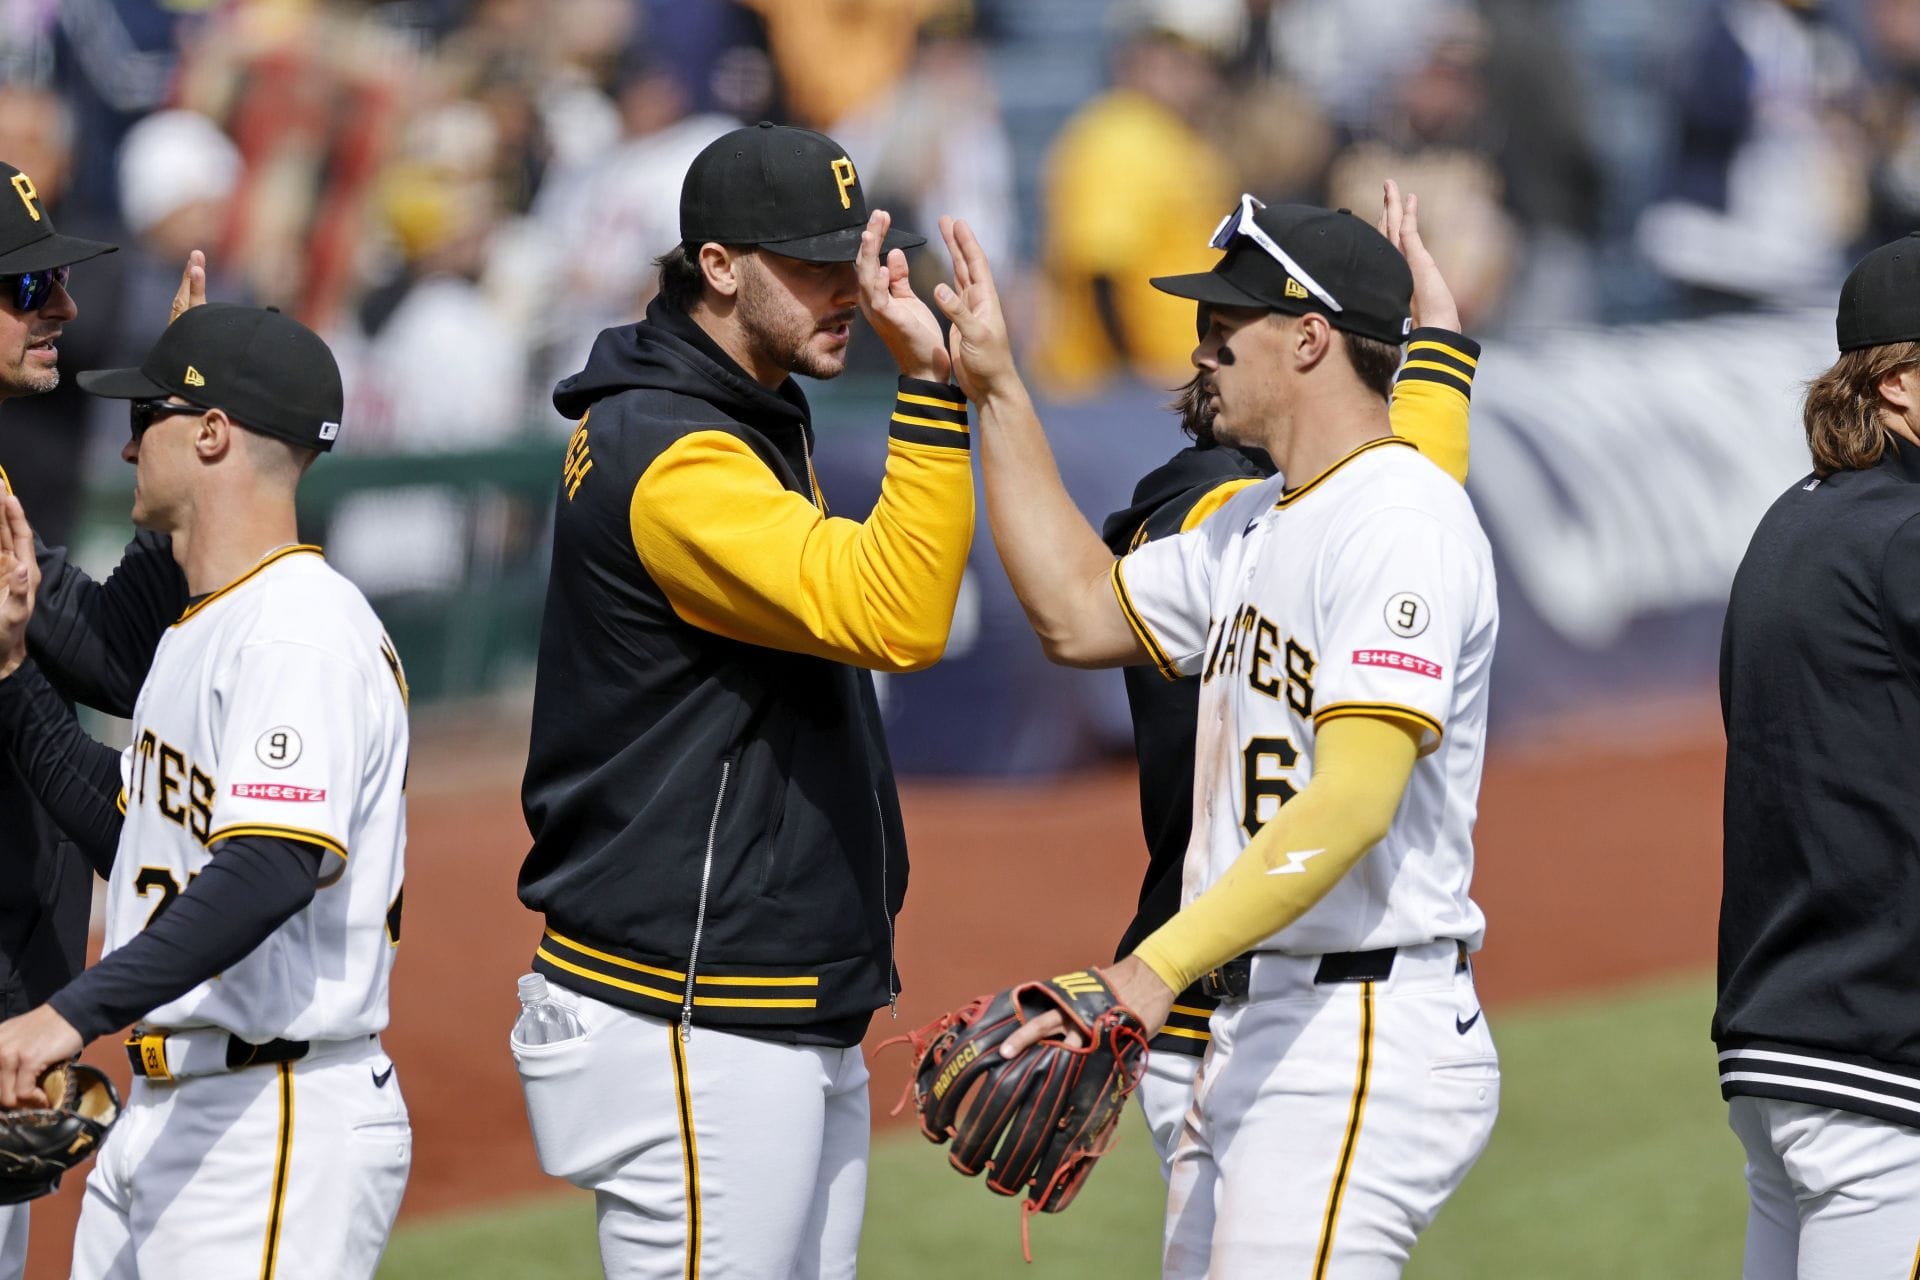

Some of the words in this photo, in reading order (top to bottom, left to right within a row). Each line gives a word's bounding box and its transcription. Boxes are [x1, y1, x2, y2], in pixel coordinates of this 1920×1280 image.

[10, 172, 40, 221] P
[831, 155, 856, 209] P
[564, 408, 593, 501] GH
[1398, 600, 1417, 629] 9
[1357, 651, 1438, 677] SHEETZ
[269, 733, 288, 760] 9
[130, 728, 216, 847] TES
[235, 784, 323, 801] SHEETZ
[1240, 736, 1301, 840] 6
